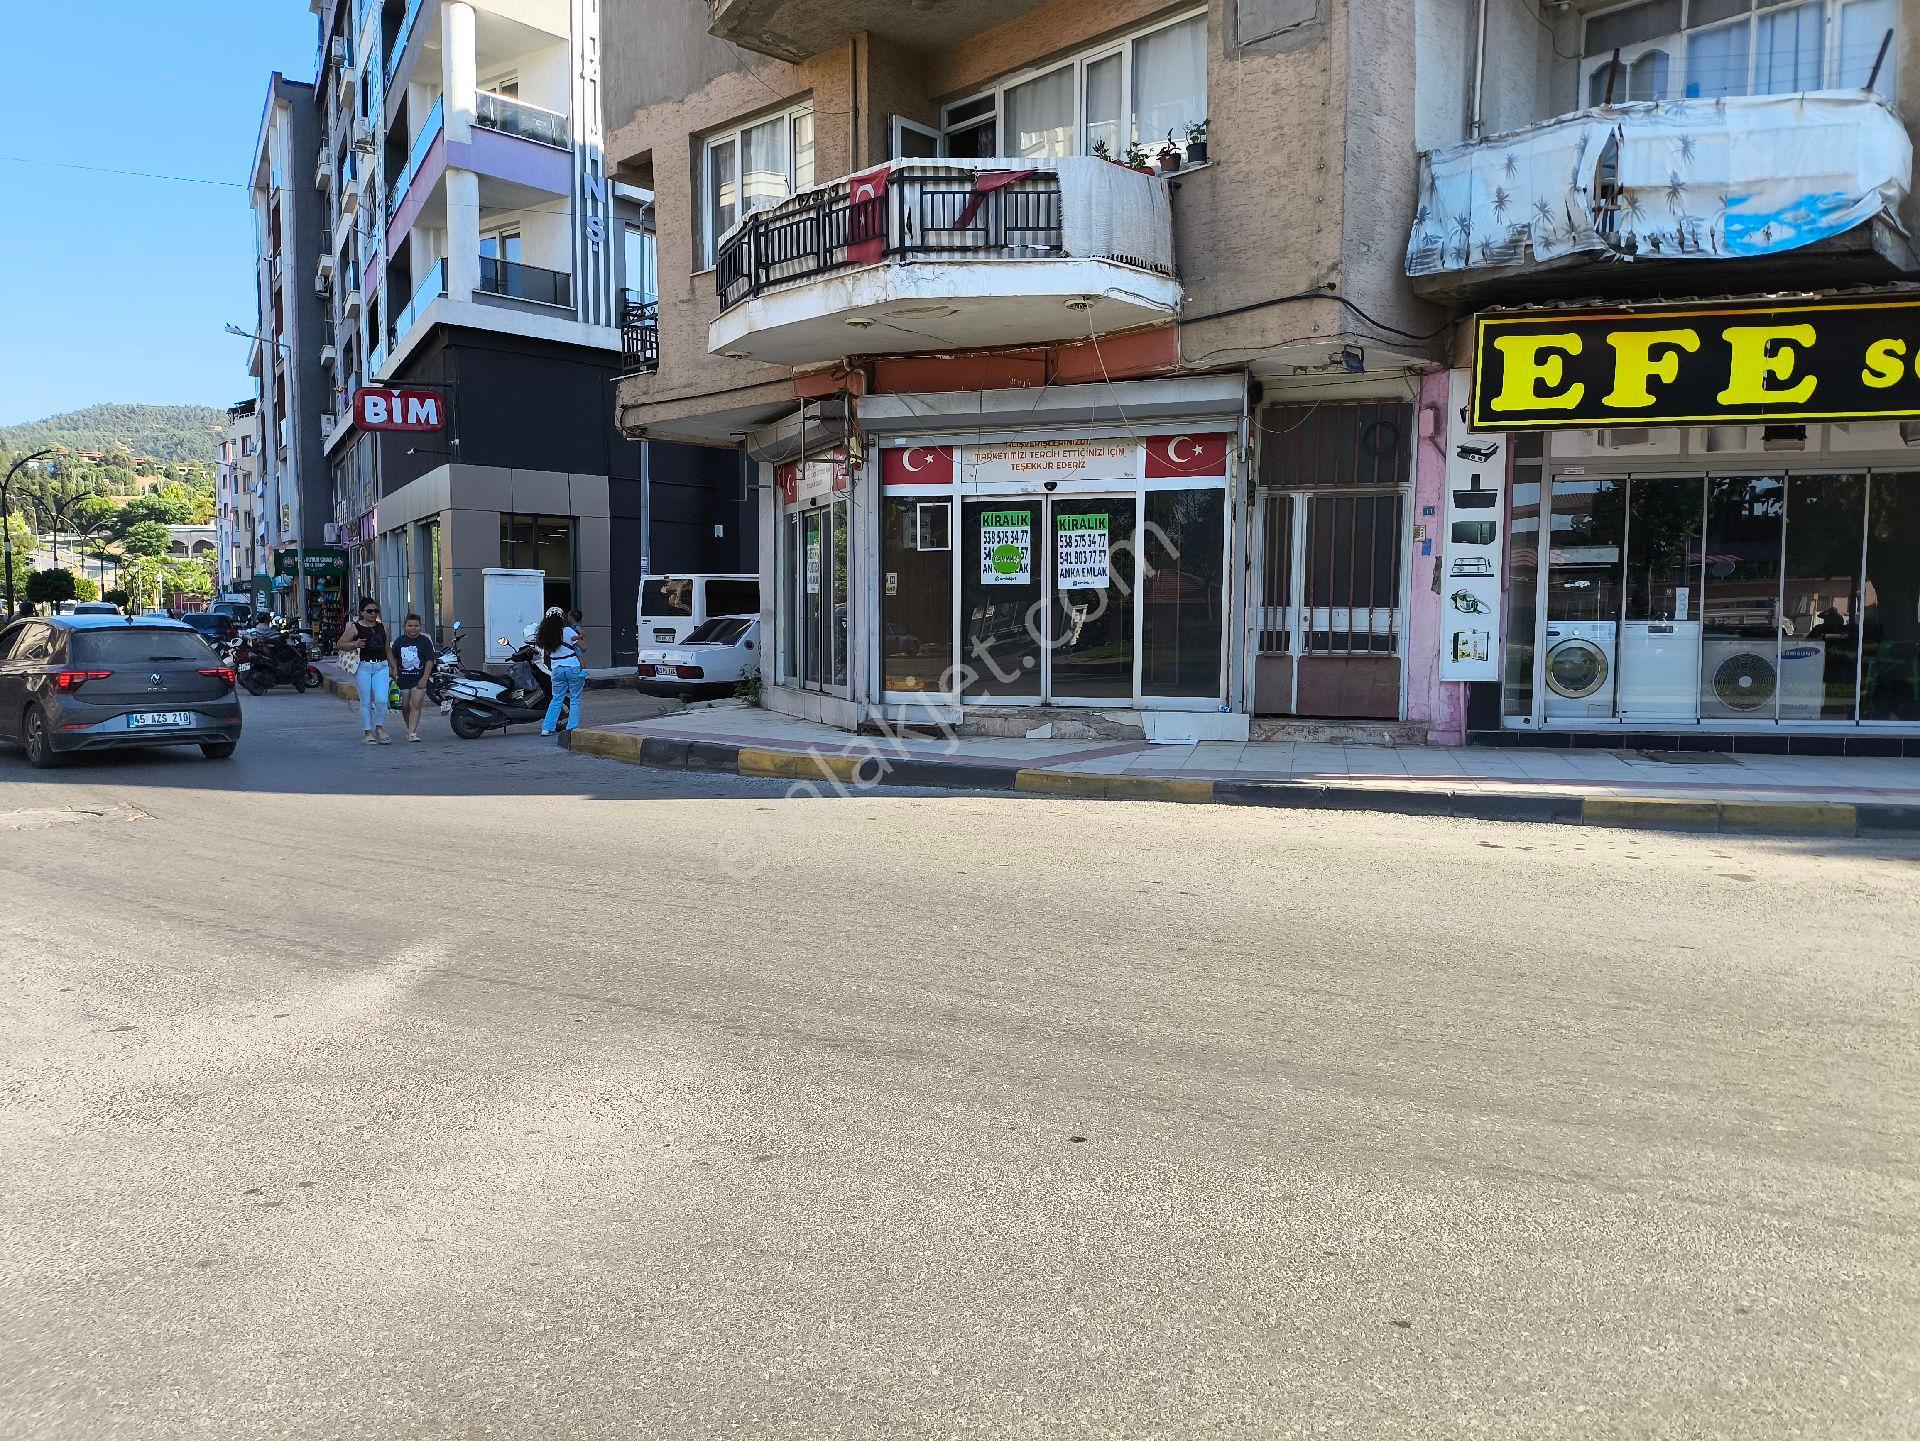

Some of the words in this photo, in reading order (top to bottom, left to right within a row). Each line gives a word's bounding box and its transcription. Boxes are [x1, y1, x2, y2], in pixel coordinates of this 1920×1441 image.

[1490, 323, 1818, 412] EFE
[1861, 337, 1920, 389] S
[364, 389, 438, 425] BİM
[982, 512, 1028, 527] KİRALIK
[1058, 515, 1107, 531] KİRALIK
[1010, 530, 1019, 544] 34
[1020, 529, 1028, 544] 77
[1059, 534, 1073, 549] 538
[1087, 533, 1096, 547] 34
[1098, 533, 1107, 547] 77
[1088, 550, 1097, 564] 77
[1098, 550, 1107, 563] 57
[1059, 567, 1081, 579] ANKA
[1081, 566, 1107, 578] EMLAK
